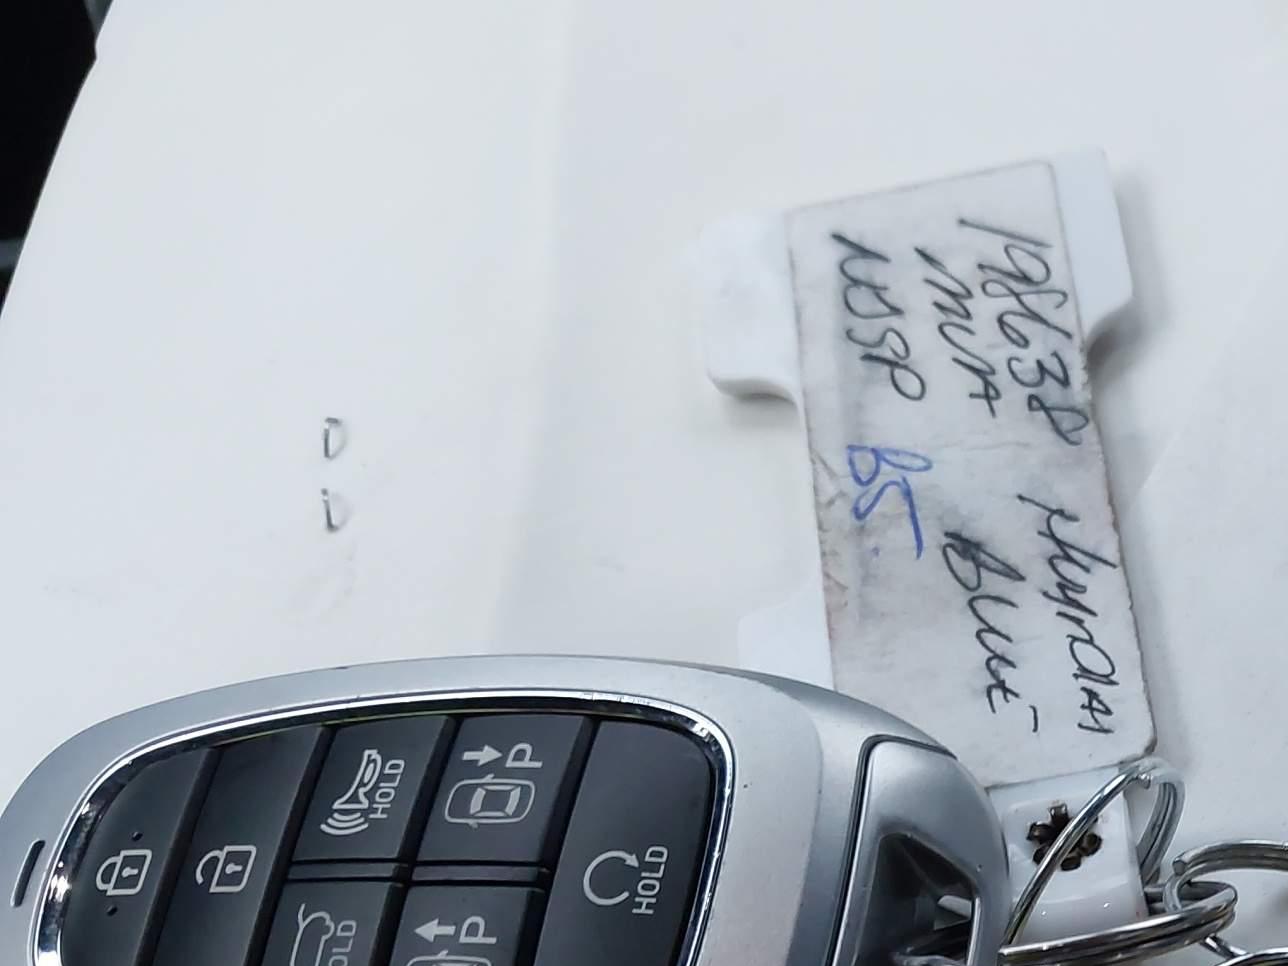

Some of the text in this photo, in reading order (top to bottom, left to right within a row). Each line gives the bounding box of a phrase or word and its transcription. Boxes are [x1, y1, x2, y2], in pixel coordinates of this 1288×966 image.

[505, 742, 544, 769] P
[368, 758, 406, 820] HOLD
[631, 845, 669, 915] HOLD
[458, 915, 498, 945] P
